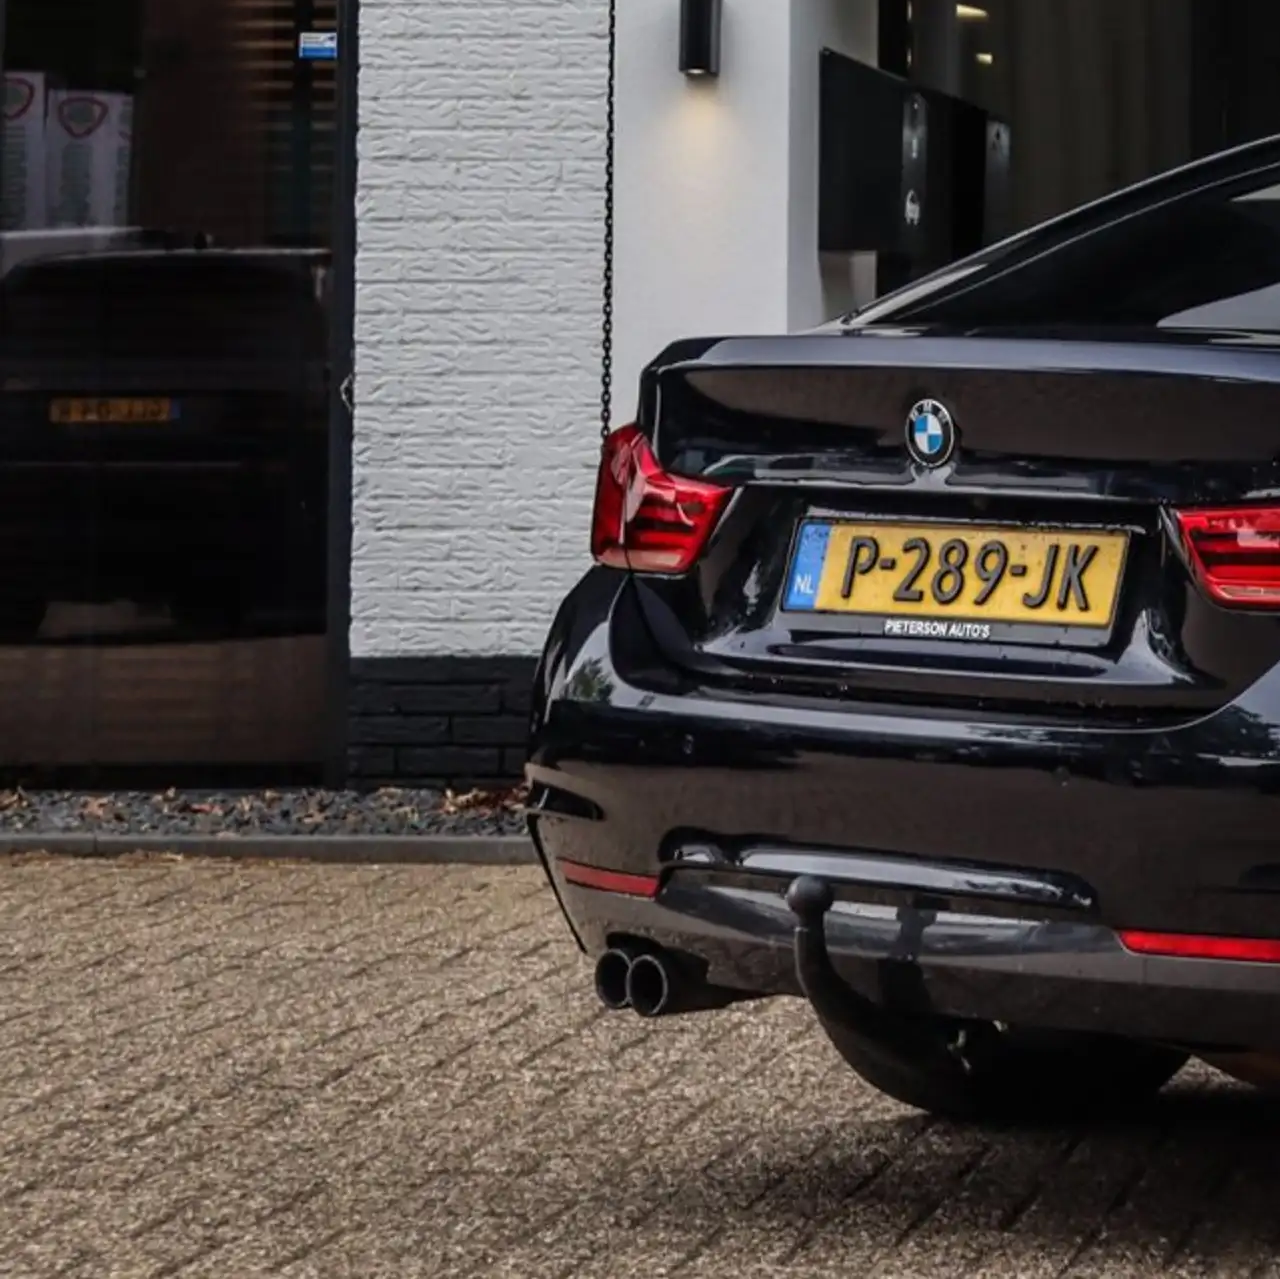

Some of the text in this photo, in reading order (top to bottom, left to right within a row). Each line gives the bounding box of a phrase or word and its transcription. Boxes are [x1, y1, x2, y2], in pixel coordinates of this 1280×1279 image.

[840, 535, 1100, 612] P-289-JK
[793, 575, 814, 595] NL
[884, 619, 990, 639] PIETERSON AUTO'S
